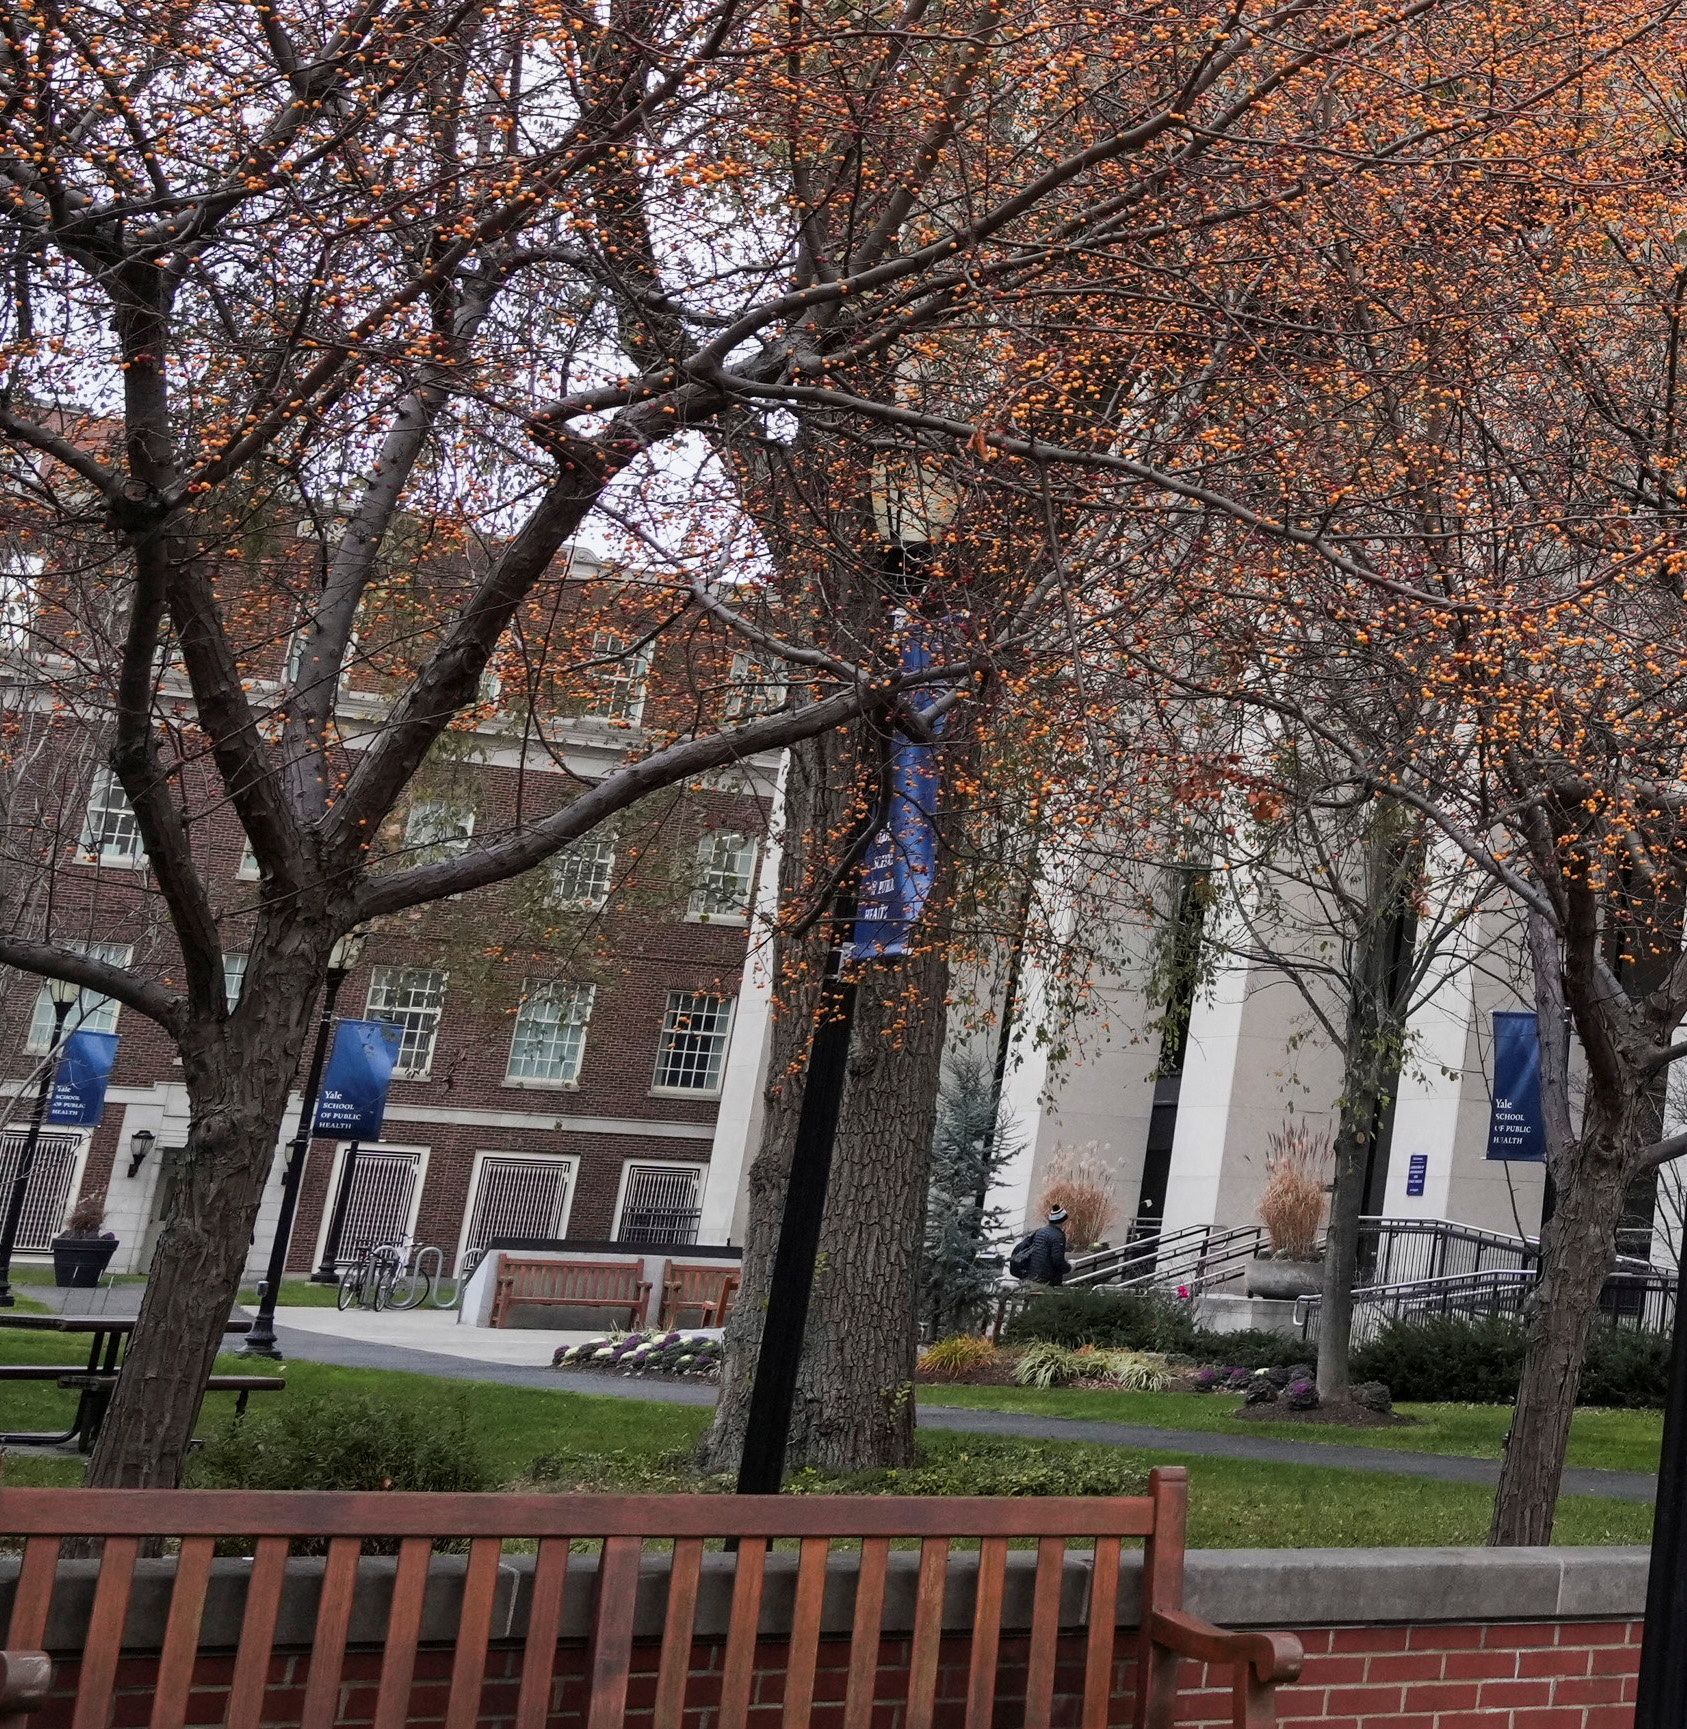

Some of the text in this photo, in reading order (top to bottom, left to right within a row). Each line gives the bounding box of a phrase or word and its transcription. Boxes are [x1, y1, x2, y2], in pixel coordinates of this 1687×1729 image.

[325, 1090, 343, 1100] Yale
[322, 1102, 355, 1110] SCHOOL
[1495, 1098, 1513, 1109] Yale
[332, 1112, 362, 1121] PUBLIC
[1495, 1113, 1525, 1121] SCHOOL
[1506, 1125, 1532, 1133] PUBLIC
